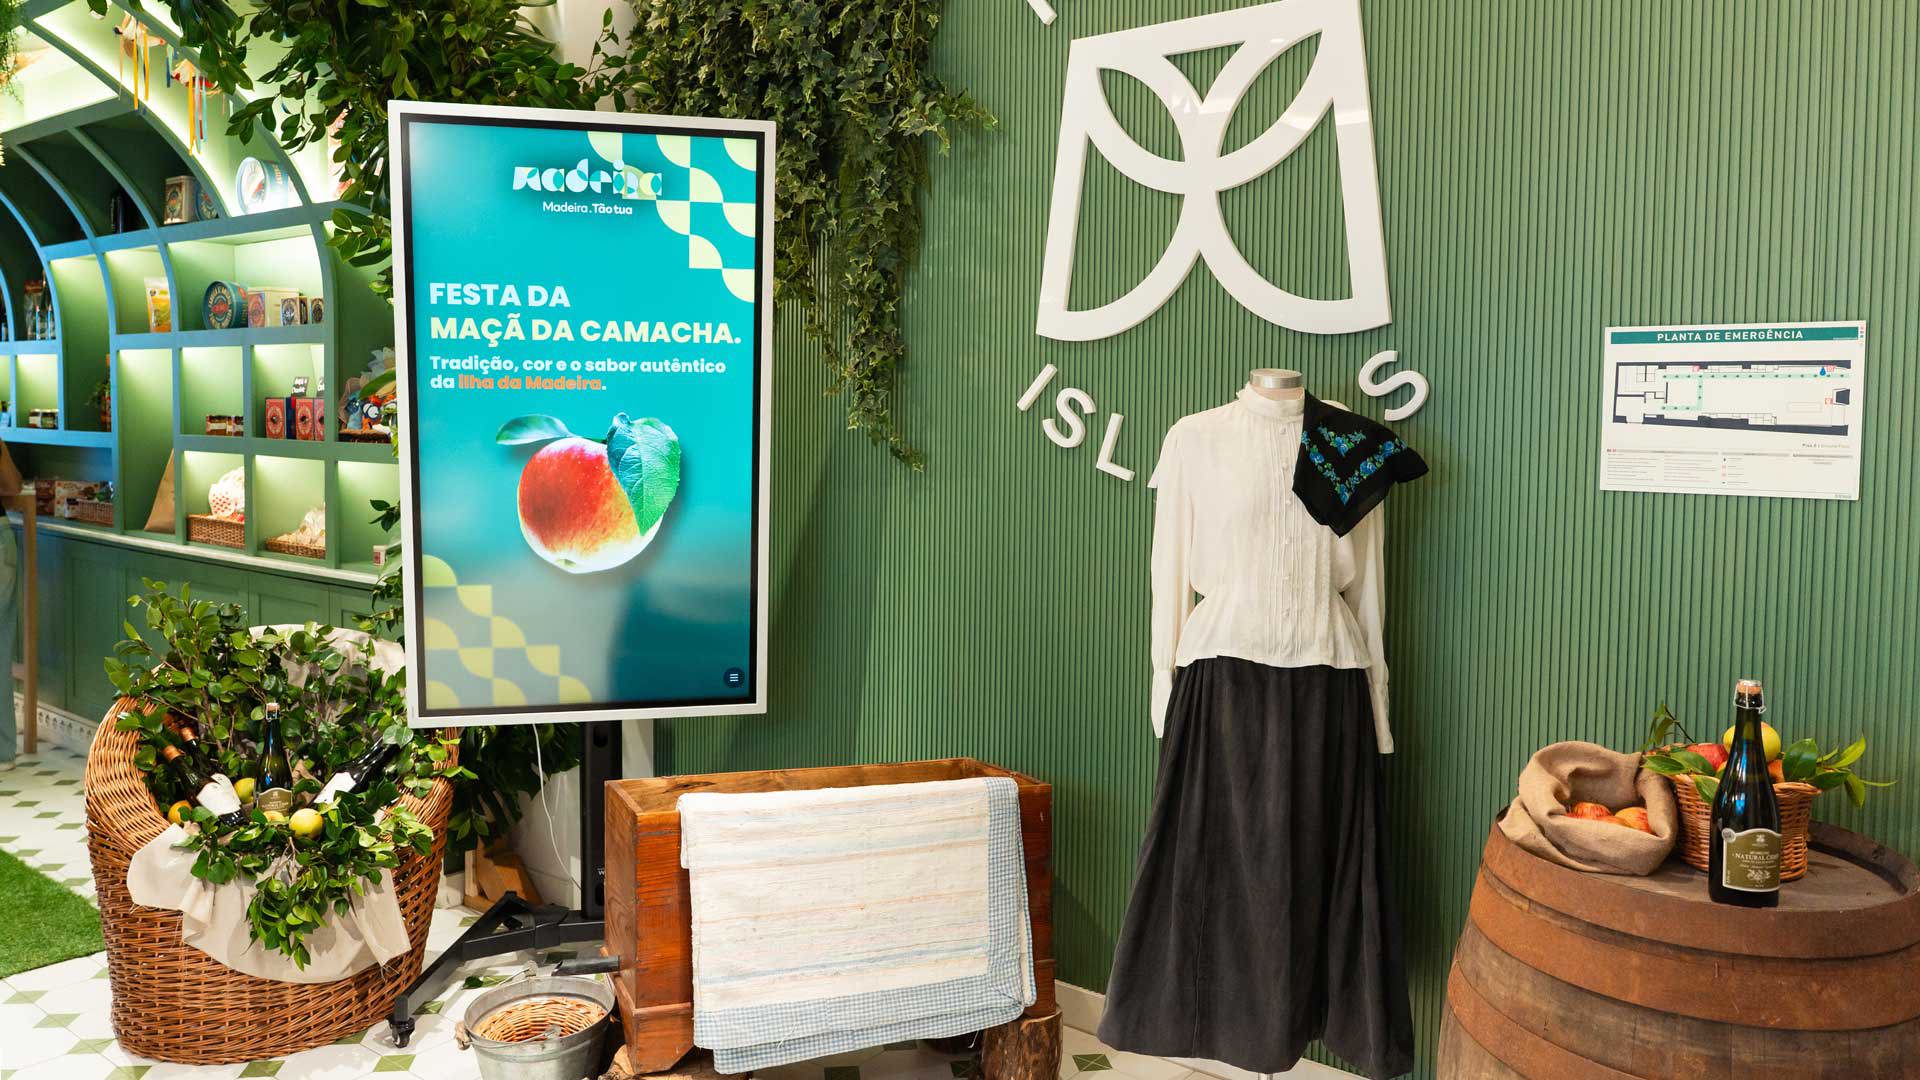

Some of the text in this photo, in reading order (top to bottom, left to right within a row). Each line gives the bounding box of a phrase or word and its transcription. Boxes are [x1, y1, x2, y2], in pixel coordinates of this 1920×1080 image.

[429, 282, 571, 307] FESTA DA
[430, 312, 742, 348] MAÇÃ DA CAMACHA.
[1656, 329, 1804, 342] PLANTA DE EMERGÊNCIA
[429, 355, 727, 375] Tradição, cor e o sabor autêntico
[430, 374, 607, 390] da Ilha da Madeira.
[1735, 852, 1766, 861] NATURAL
